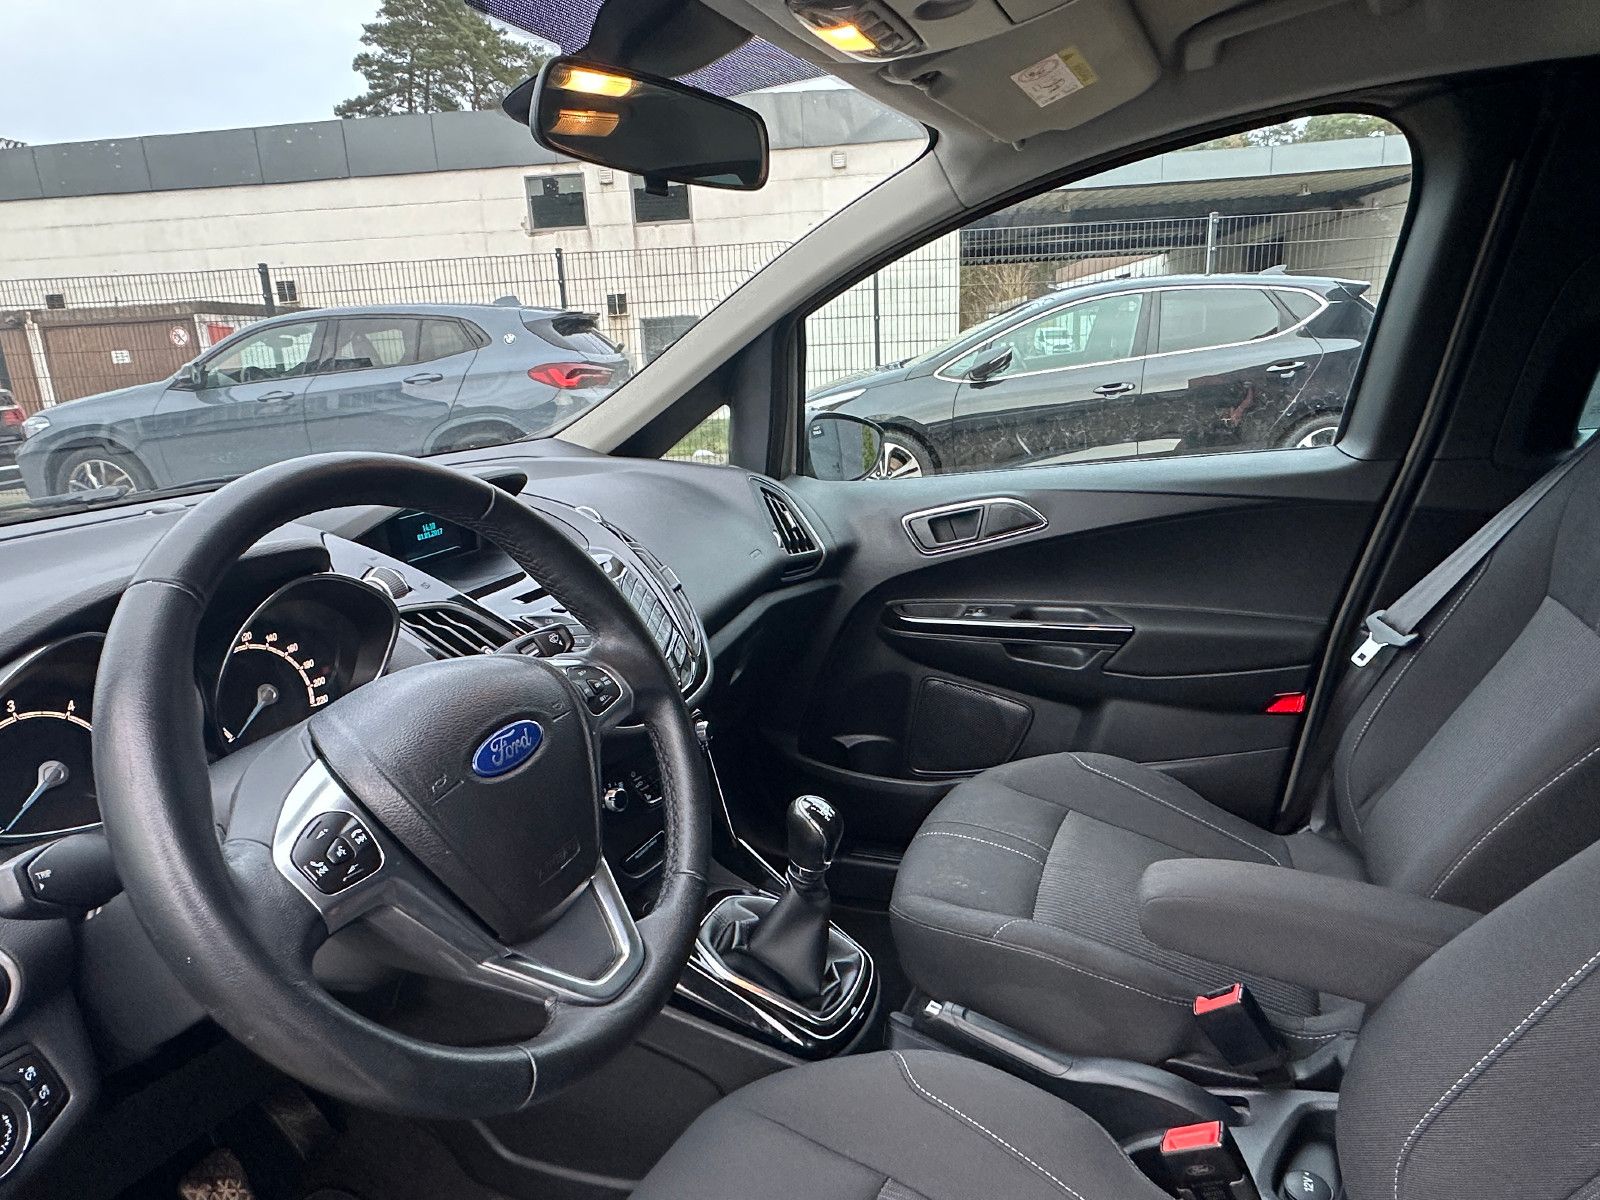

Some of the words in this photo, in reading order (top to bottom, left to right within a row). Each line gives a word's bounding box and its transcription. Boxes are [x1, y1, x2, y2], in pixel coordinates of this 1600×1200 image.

[6, 700, 16, 713] 3
[67, 699, 76, 712] 4
[490, 727, 533, 767] Ford
